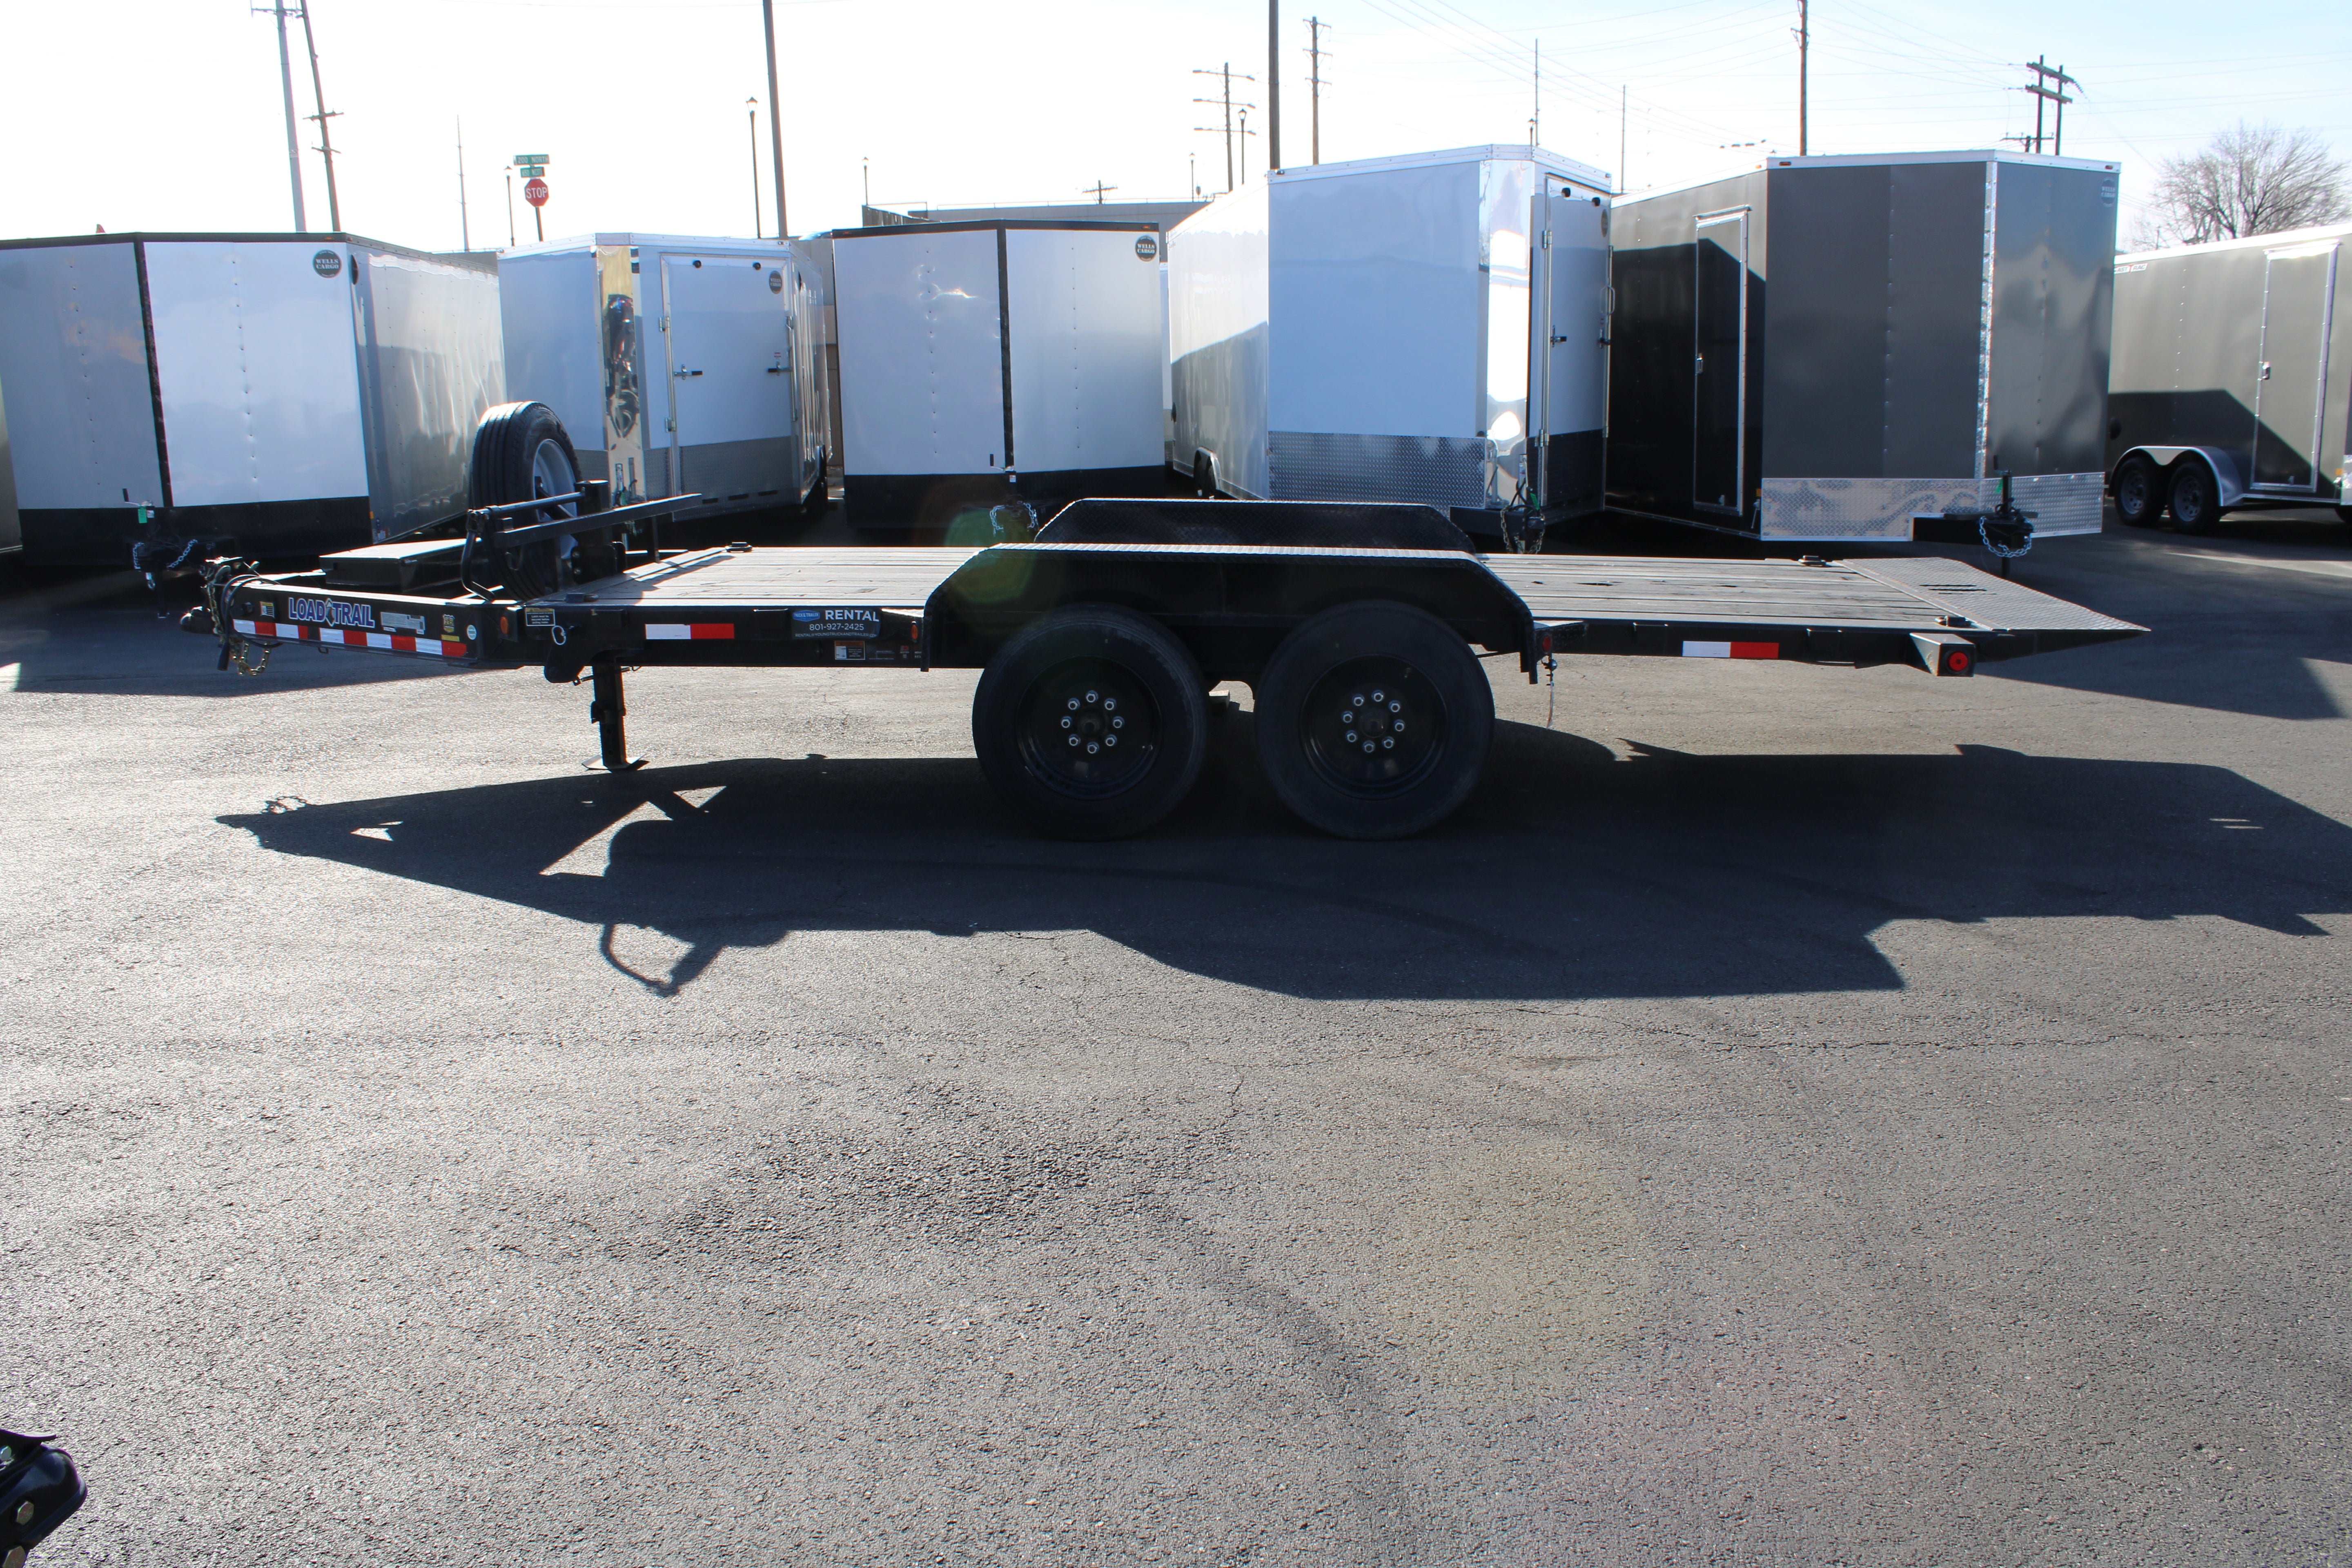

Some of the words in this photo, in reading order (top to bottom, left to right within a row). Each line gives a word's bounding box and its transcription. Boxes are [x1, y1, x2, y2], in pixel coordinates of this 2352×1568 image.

[526, 187, 547, 199] STOP
[289, 597, 326, 622] LOAD
[332, 601, 375, 628] TRAIL
[825, 610, 880, 622] RENTAL
